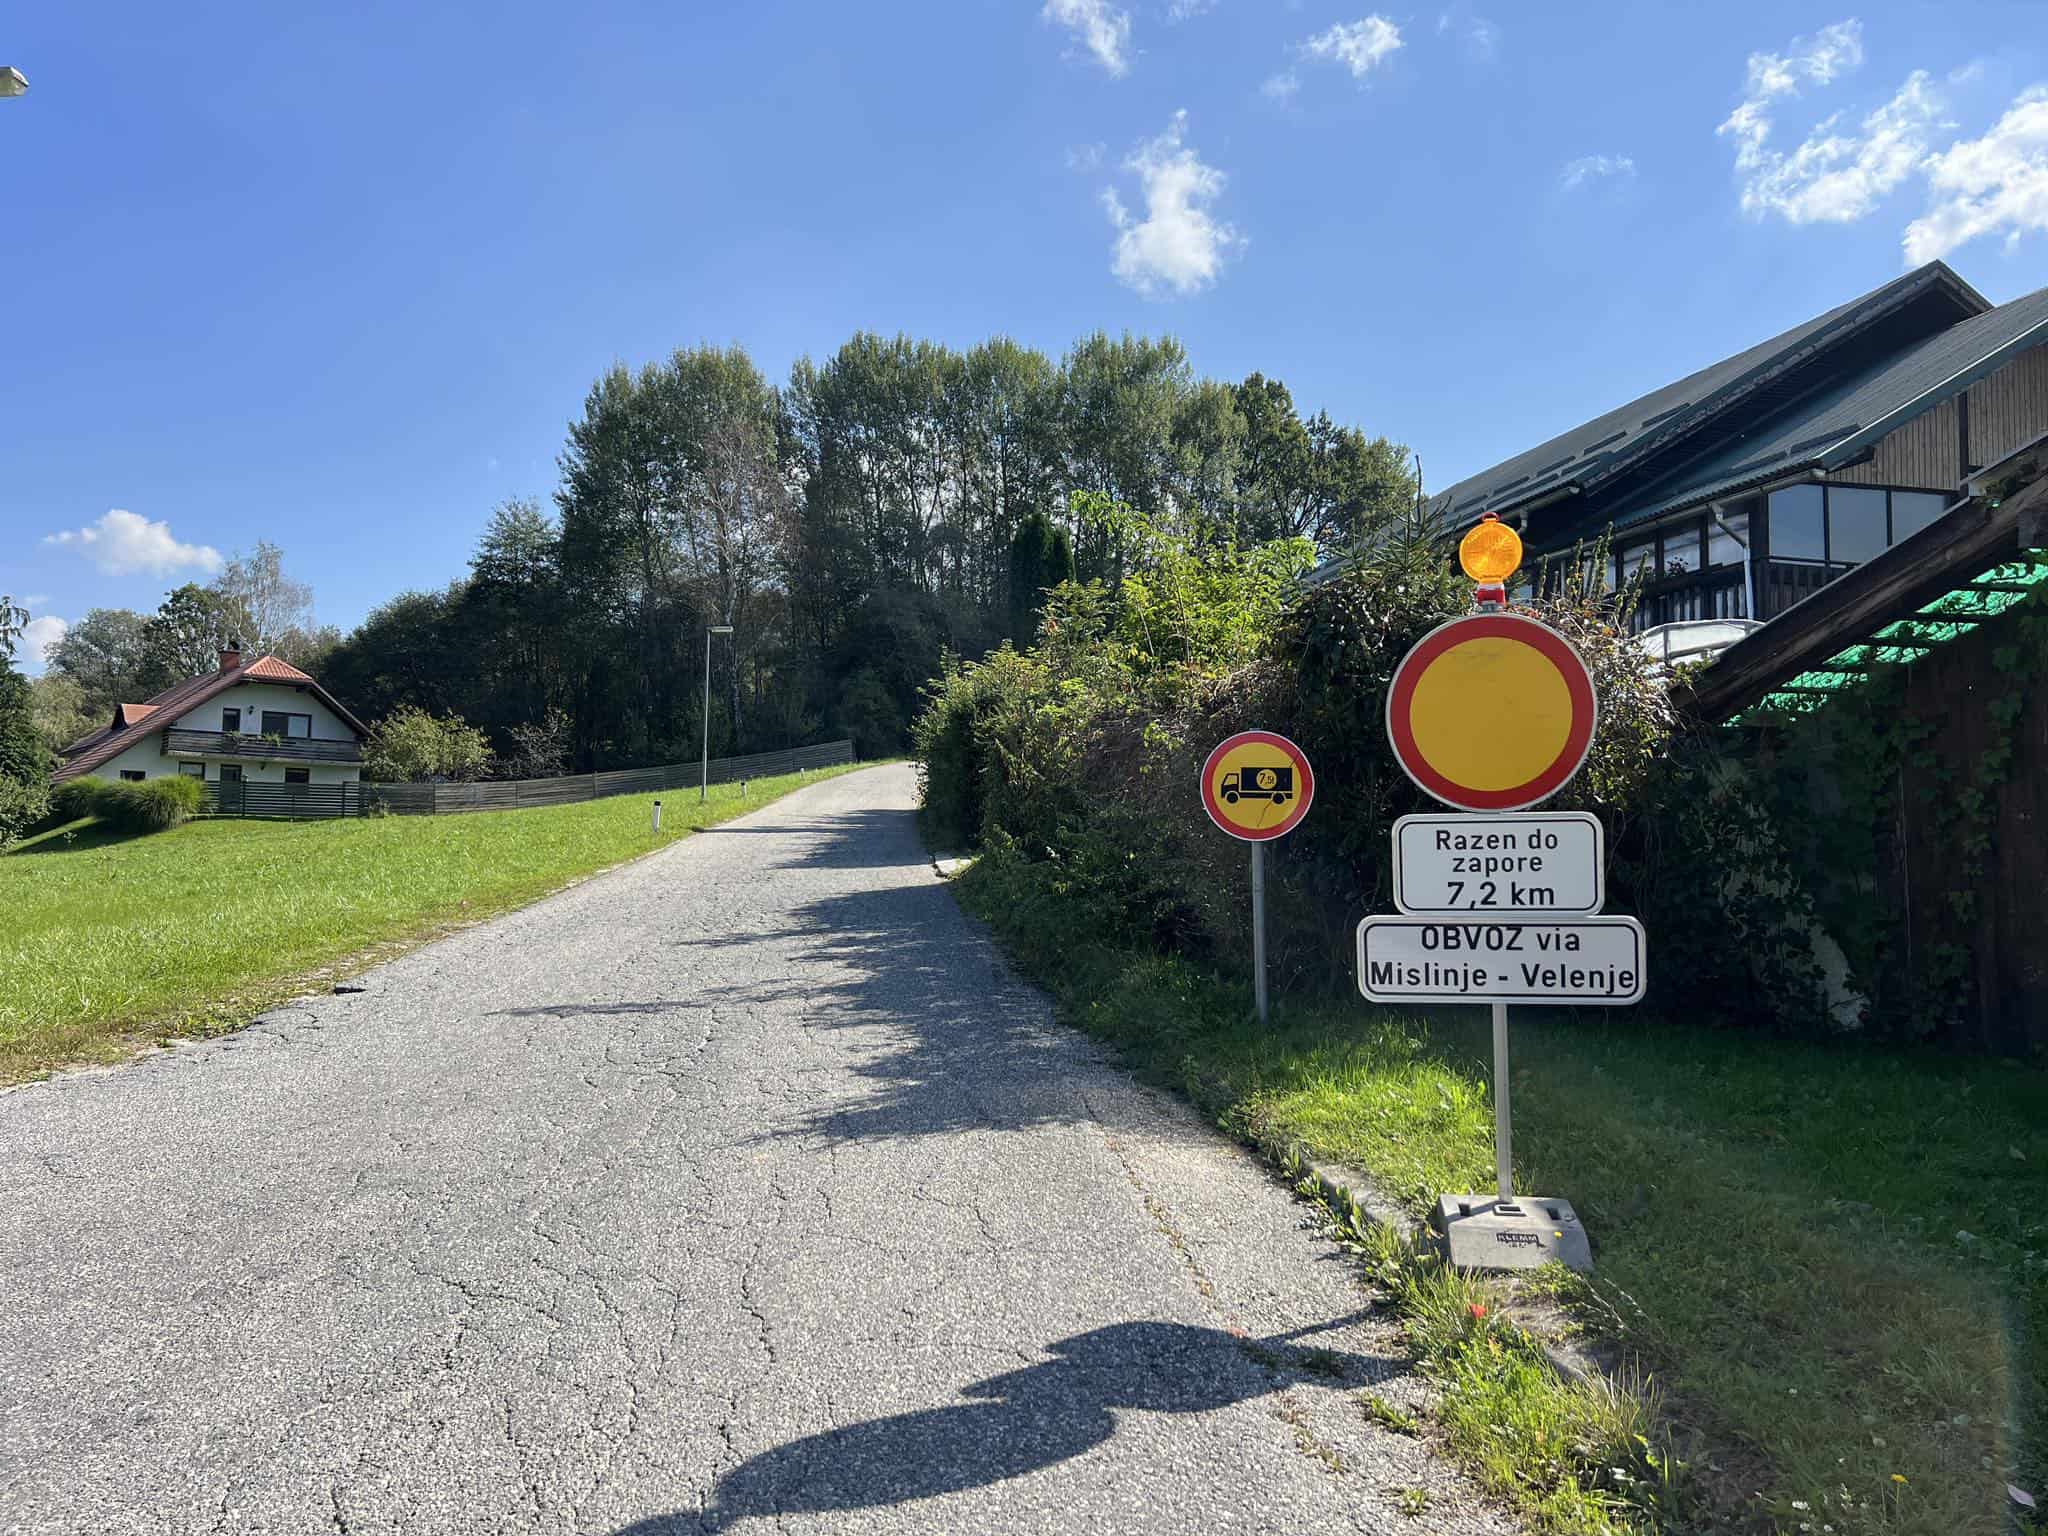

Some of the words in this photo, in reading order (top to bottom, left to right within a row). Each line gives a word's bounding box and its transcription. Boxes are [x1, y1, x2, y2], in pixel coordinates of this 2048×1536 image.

[1435, 829, 1517, 851] Razen
[1528, 828, 1559, 850] do
[1452, 856, 1544, 878] zapore
[1447, 881, 1498, 910] 7,2
[1511, 881, 1556, 906] km
[1421, 926, 1524, 951] OBVOZ
[1536, 928, 1581, 952] via
[1370, 961, 1488, 993] Mislinje
[1520, 963, 1635, 994] Velenje
